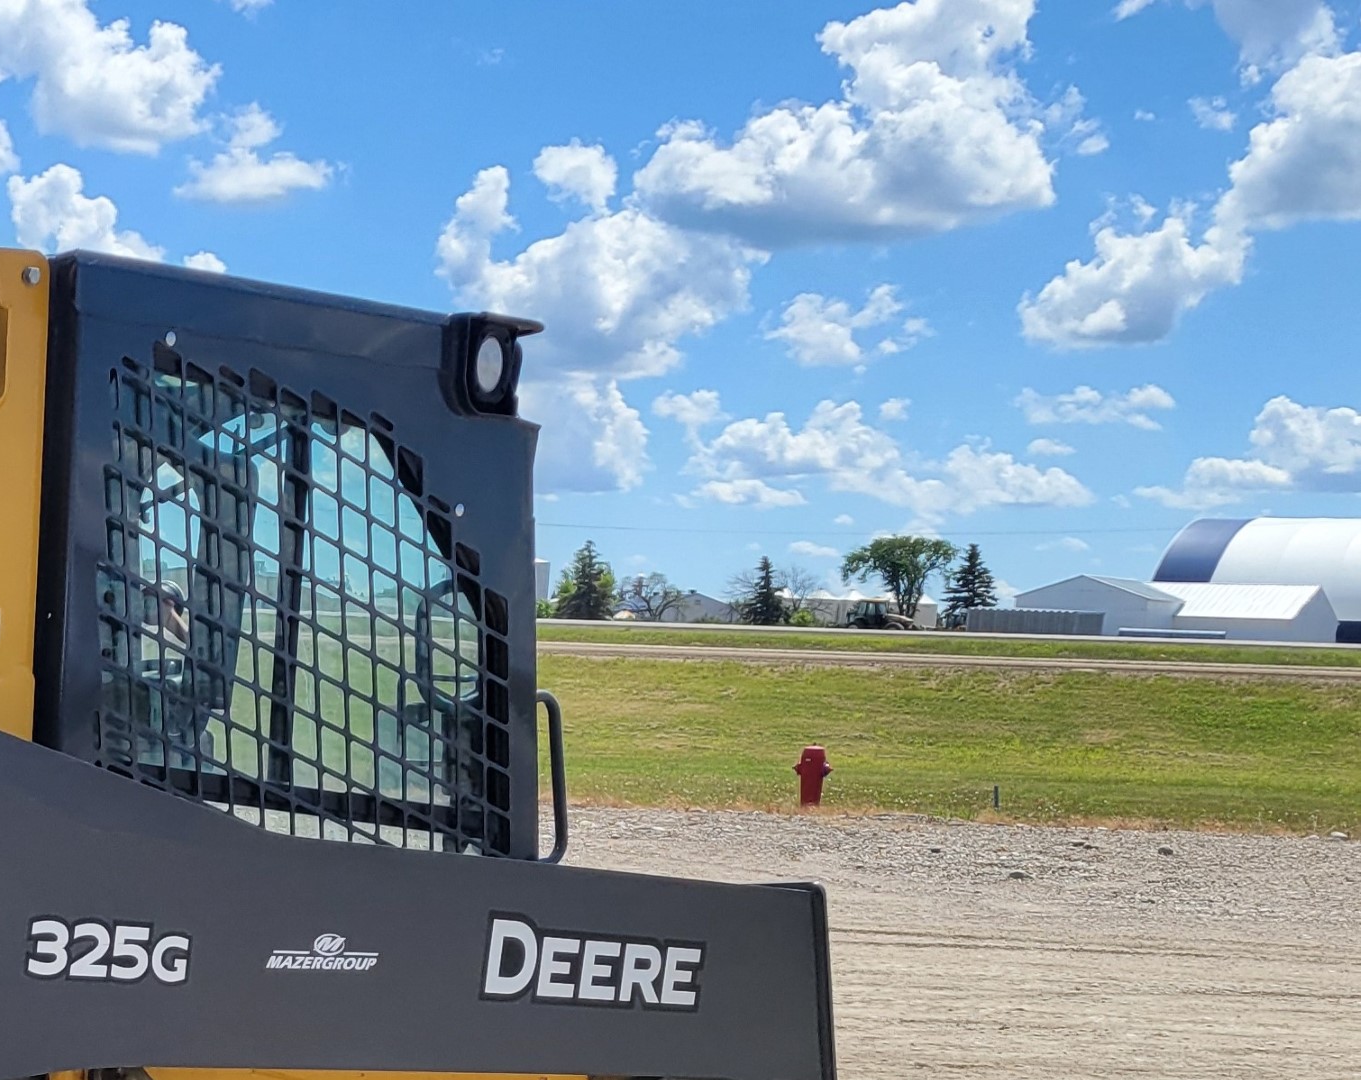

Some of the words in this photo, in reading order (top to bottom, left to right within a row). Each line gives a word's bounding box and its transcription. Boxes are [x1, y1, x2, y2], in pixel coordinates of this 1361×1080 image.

[28, 920, 190, 982] 325G
[266, 955, 378, 971] MAZERGROUP
[484, 919, 702, 1005] DEERE
